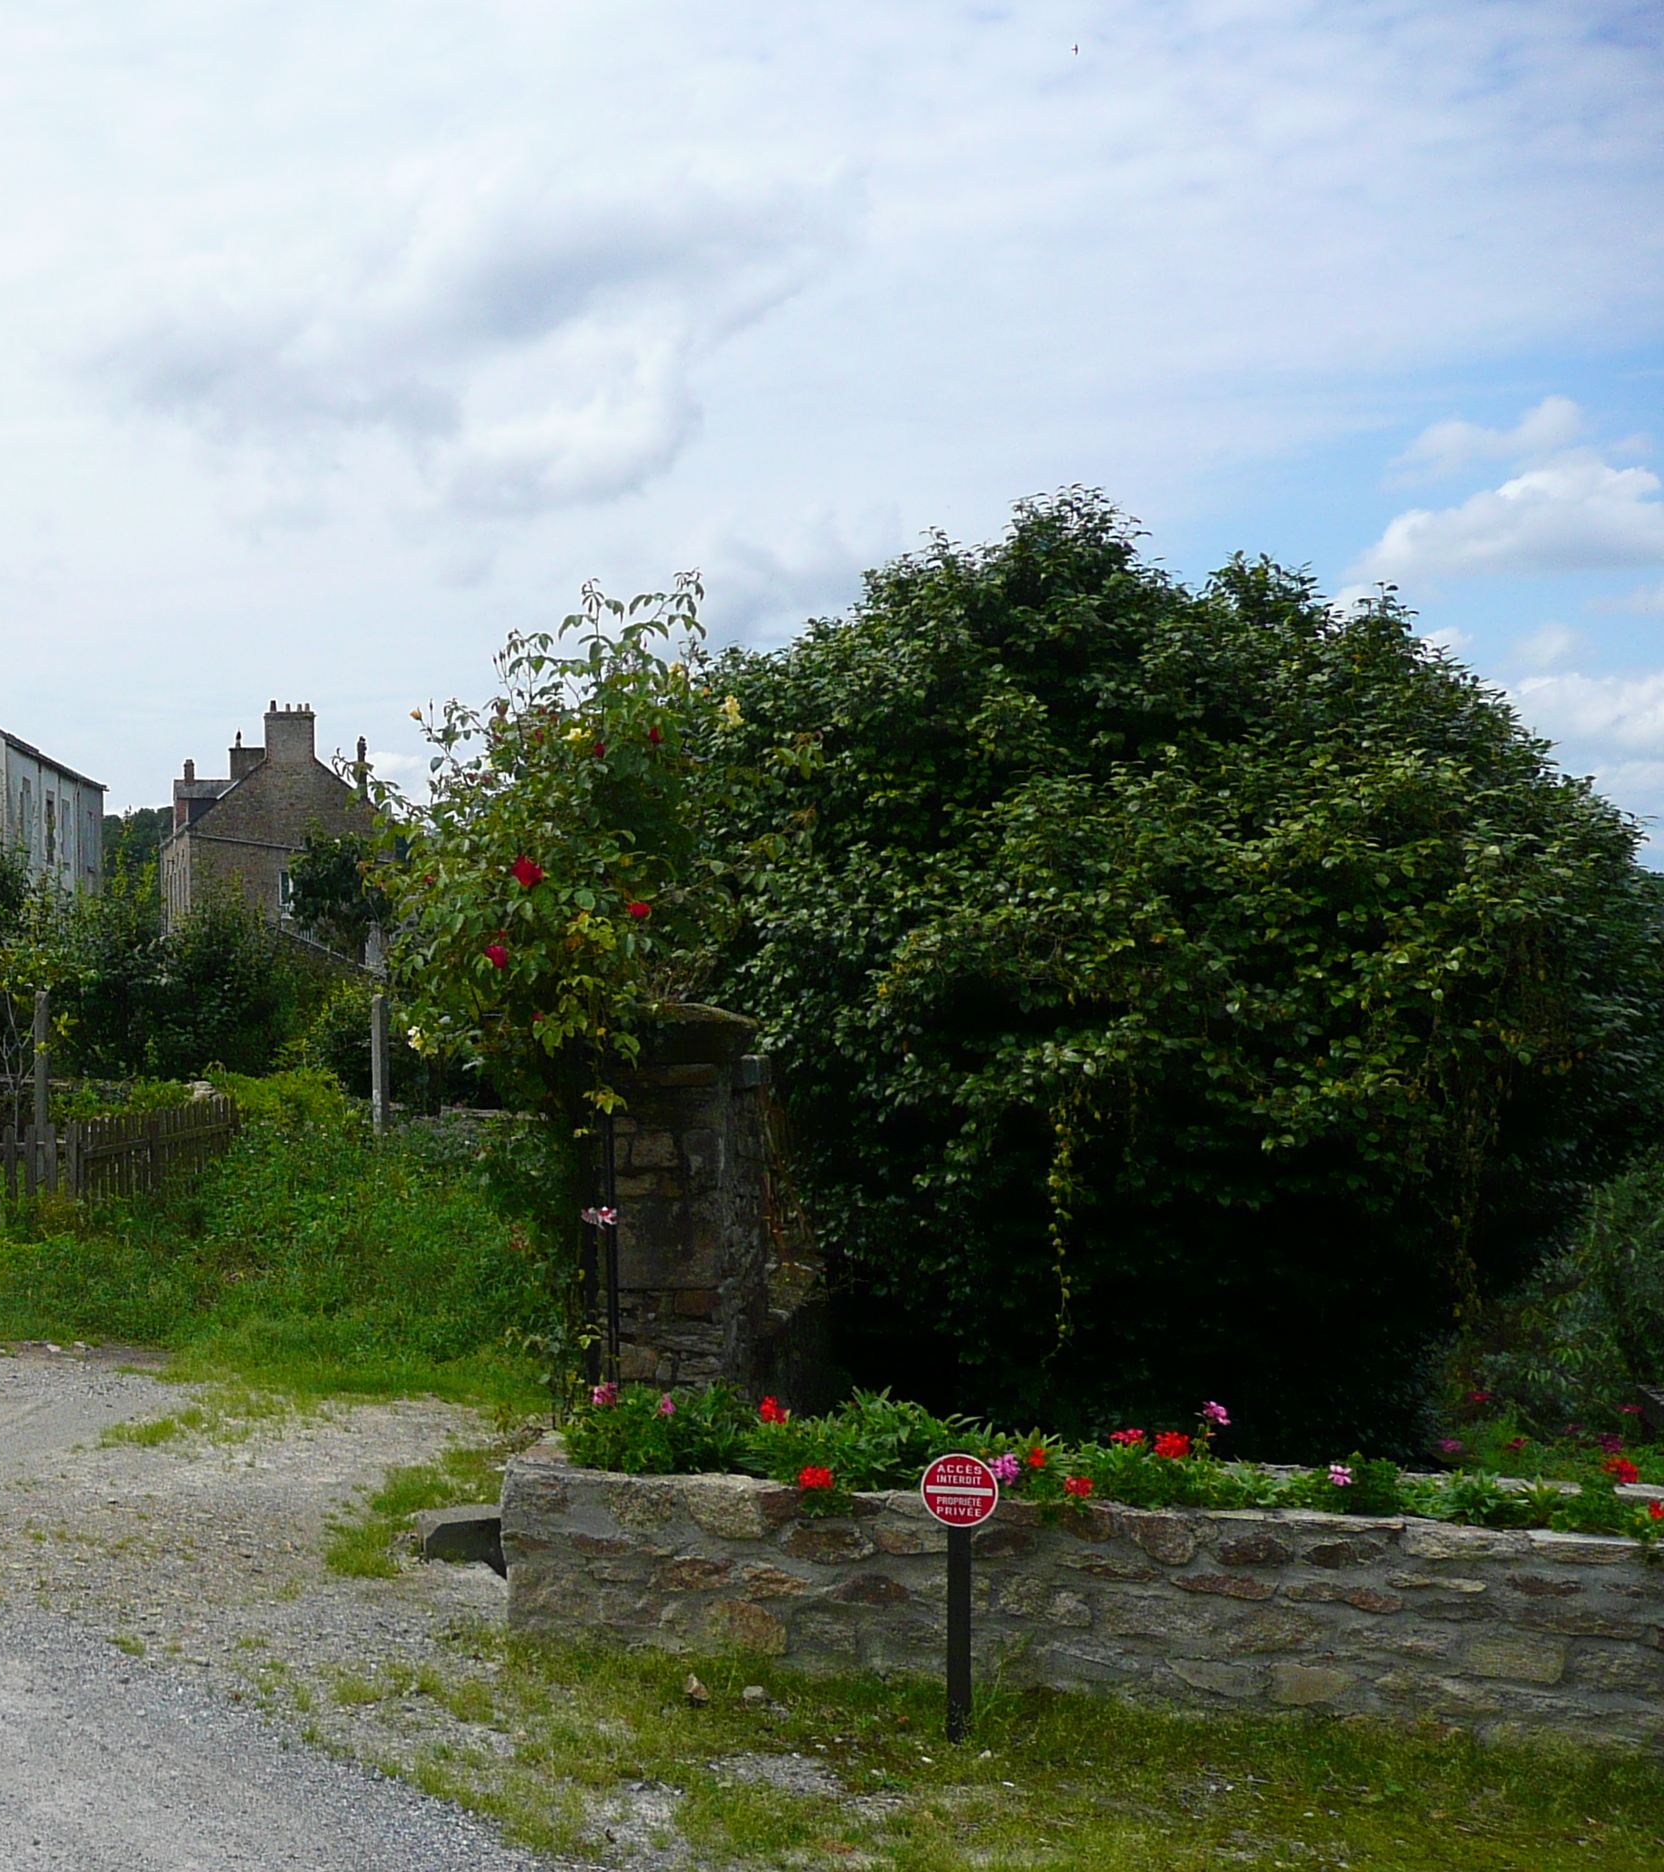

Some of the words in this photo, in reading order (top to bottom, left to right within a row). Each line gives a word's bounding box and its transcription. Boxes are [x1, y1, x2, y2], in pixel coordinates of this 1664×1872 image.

[937, 1464, 983, 1475] ACCÈS
[936, 1474, 983, 1485] INTERDIT
[936, 1496, 983, 1508] PROPRIÉTÉ
[936, 1505, 983, 1517] PRIVÉE
